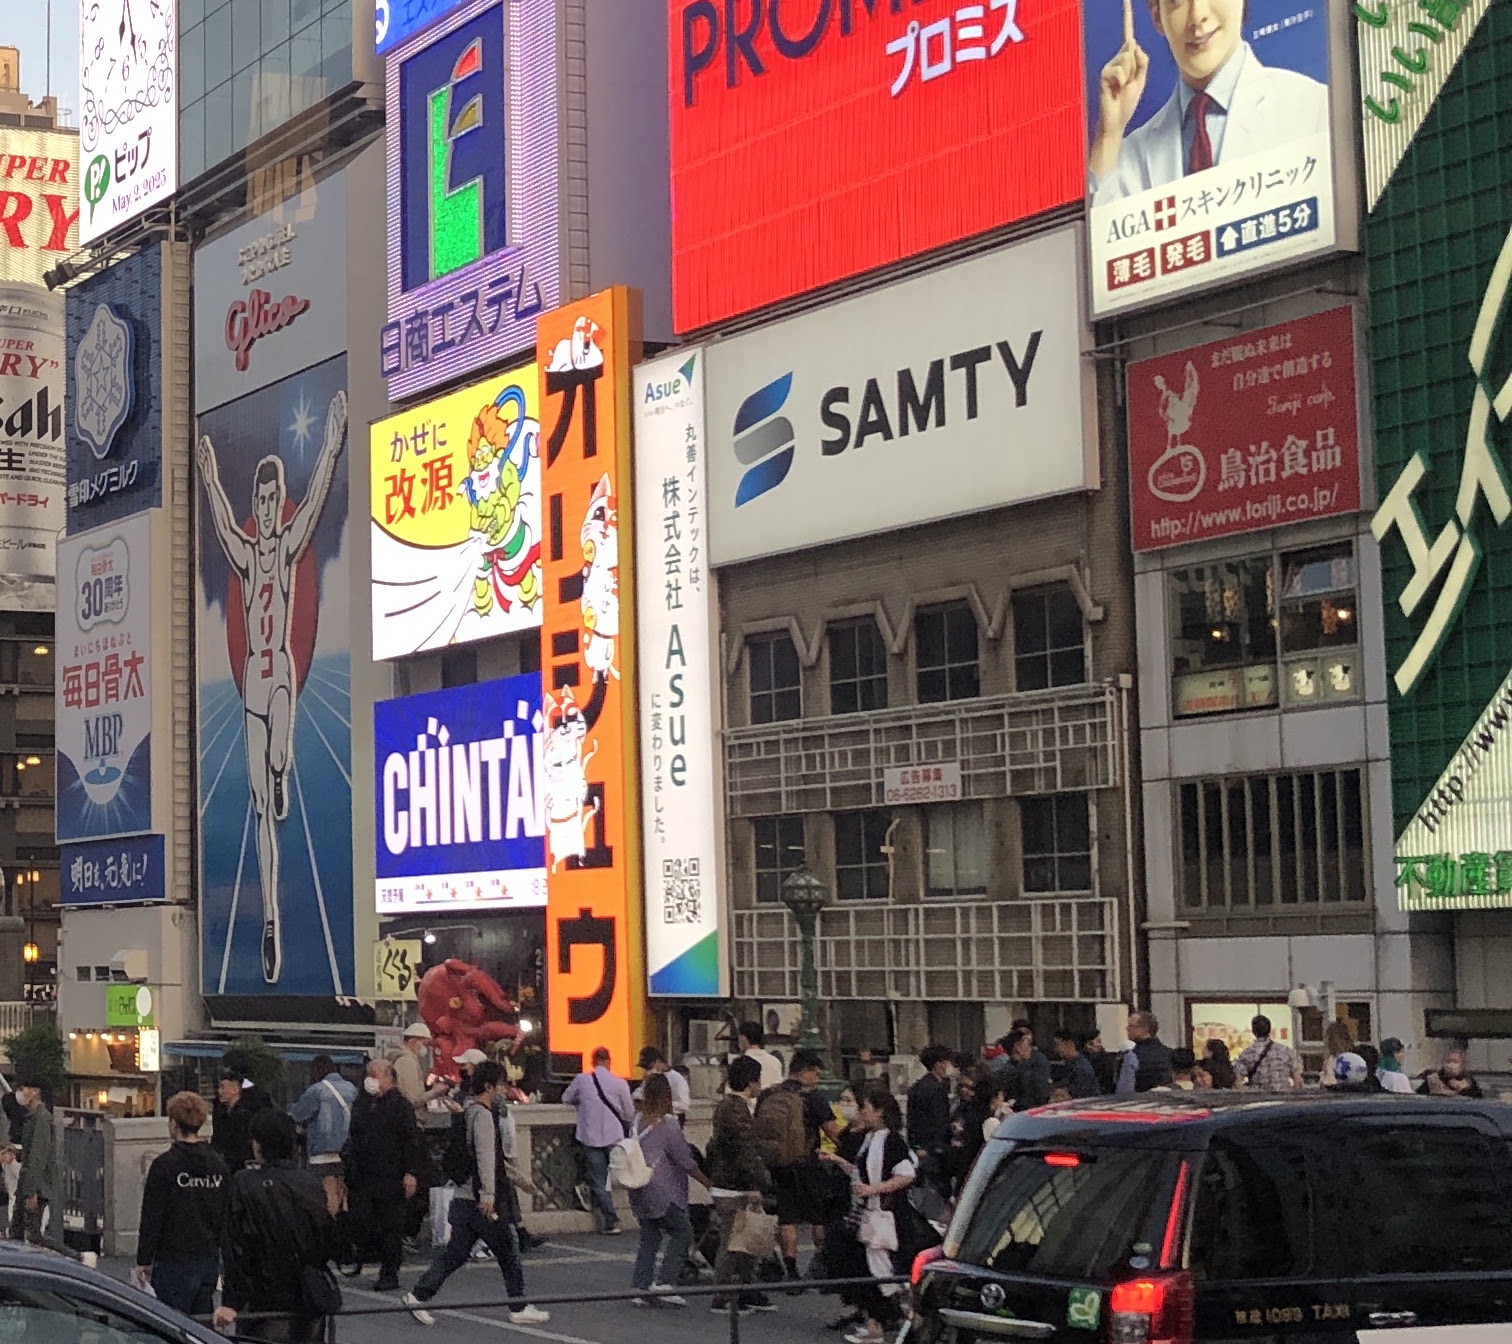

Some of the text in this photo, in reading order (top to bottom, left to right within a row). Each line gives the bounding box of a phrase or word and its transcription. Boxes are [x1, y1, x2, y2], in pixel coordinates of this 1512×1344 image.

[114, 126, 153, 184] ピップ
[1180, 155, 1317, 222] スキンクリニック
[1105, 208, 1151, 245] AGA
[1165, 234, 1207, 271] 発毛
[1240, 203, 1313, 247] 直進5分
[1112, 250, 1151, 286] 薄毛
[225, 289, 311, 372] Glico
[380, 264, 543, 379] 日商エステム
[644, 378, 681, 404] Asue
[820, 330, 1043, 456] SAMTY
[390, 419, 448, 463] かぜに
[1217, 426, 1343, 493] 鳥治食品
[68, 459, 138, 508] 雪印メグミルク
[384, 452, 454, 526] 改源
[684, 423, 701, 594] 丸善インテックは、
[1150, 483, 1338, 541] http://www.toriji.co.jp/
[258, 582, 274, 680] グリコ
[662, 476, 687, 787] 株式会社 Asue
[62, 650, 145, 710] 毎日骨太
[83, 713, 124, 760] MBP
[651, 692, 666, 844] に変わりました。
[899, 767, 943, 786] 広告募集
[1311, 1303, 1350, 1321] TAXI
